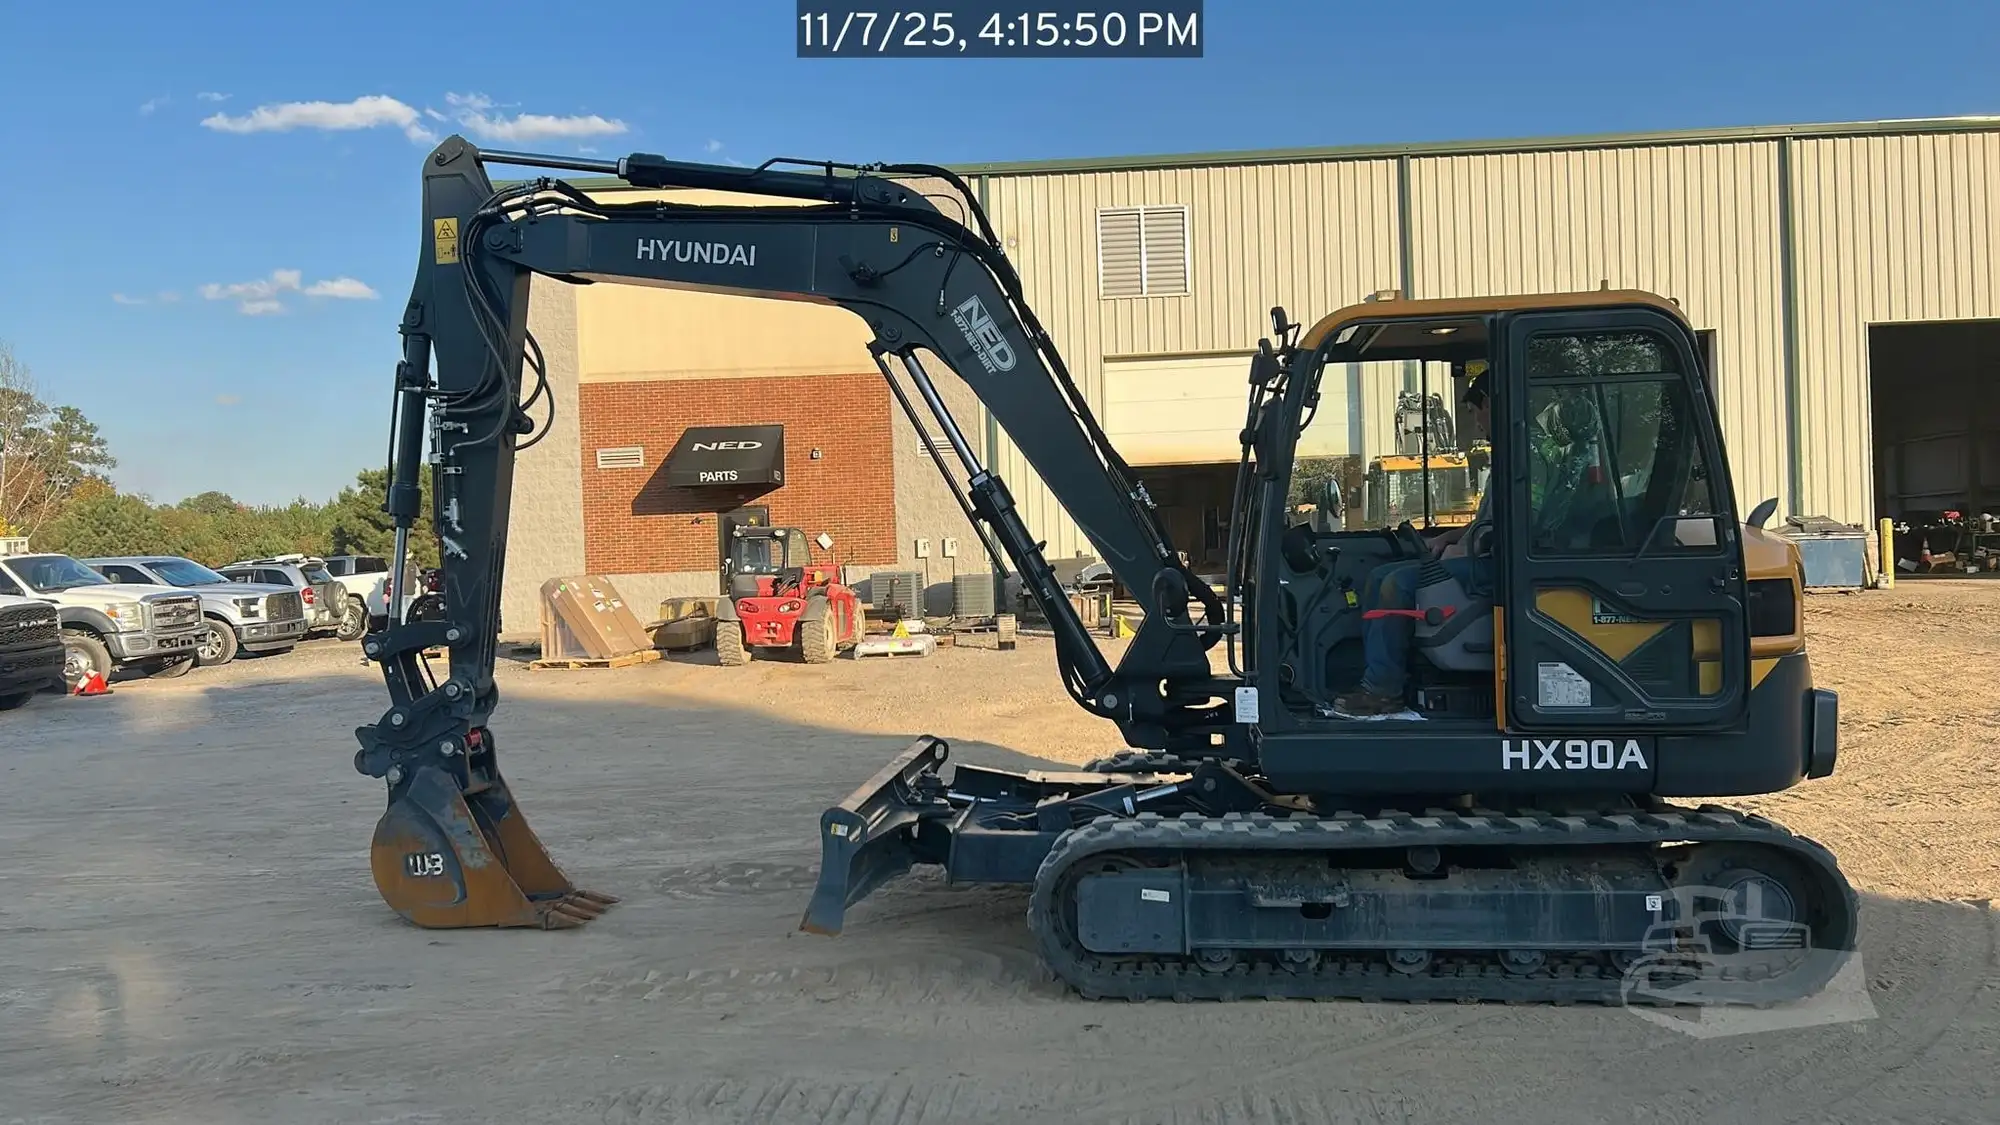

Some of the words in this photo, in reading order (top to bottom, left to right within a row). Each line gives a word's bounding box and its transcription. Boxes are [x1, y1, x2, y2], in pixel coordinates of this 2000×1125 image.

[637, 238, 756, 266] HYUNDAI
[958, 295, 1015, 370] NED
[692, 441, 763, 451] NED
[699, 470, 738, 482] PARTS
[1502, 739, 1649, 770] HX90A
